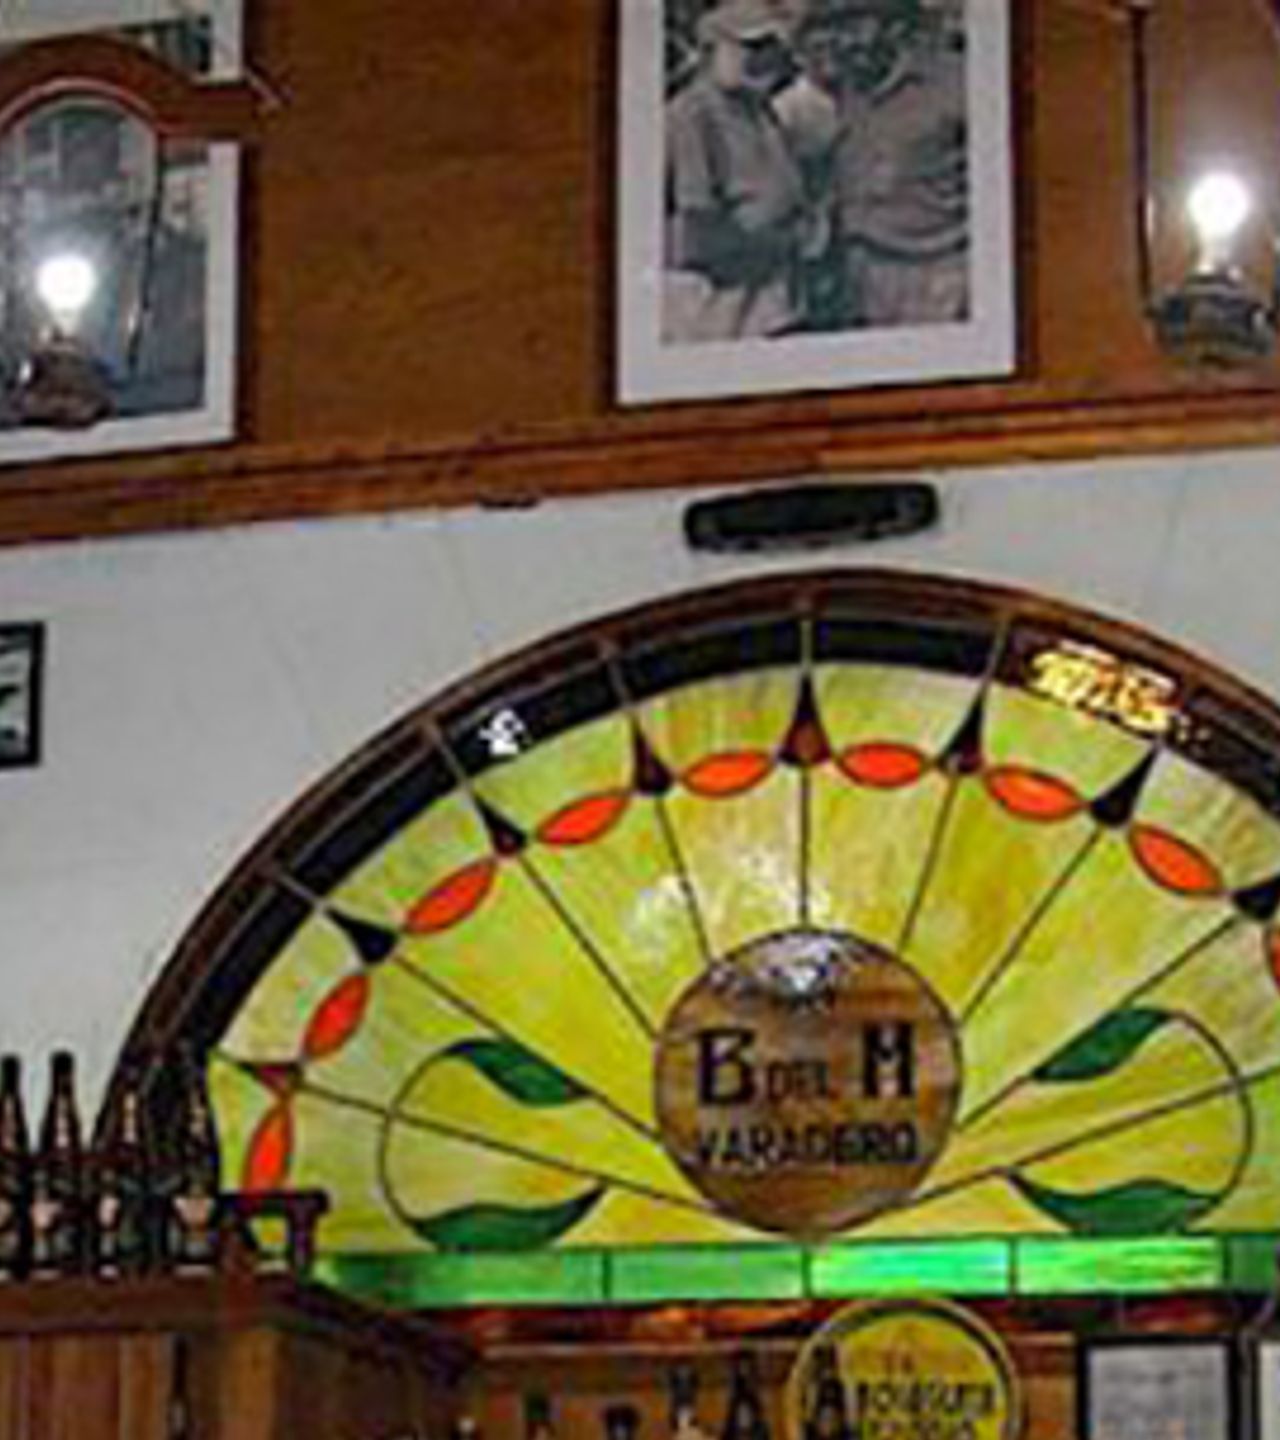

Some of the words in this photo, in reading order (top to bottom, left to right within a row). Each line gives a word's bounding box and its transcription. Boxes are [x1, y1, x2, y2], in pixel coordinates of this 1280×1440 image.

[697, 1026, 756, 1106] B
[765, 1058, 838, 1102] DEL
[860, 1018, 916, 1100] M
[690, 1120, 918, 1166] VARADERO
